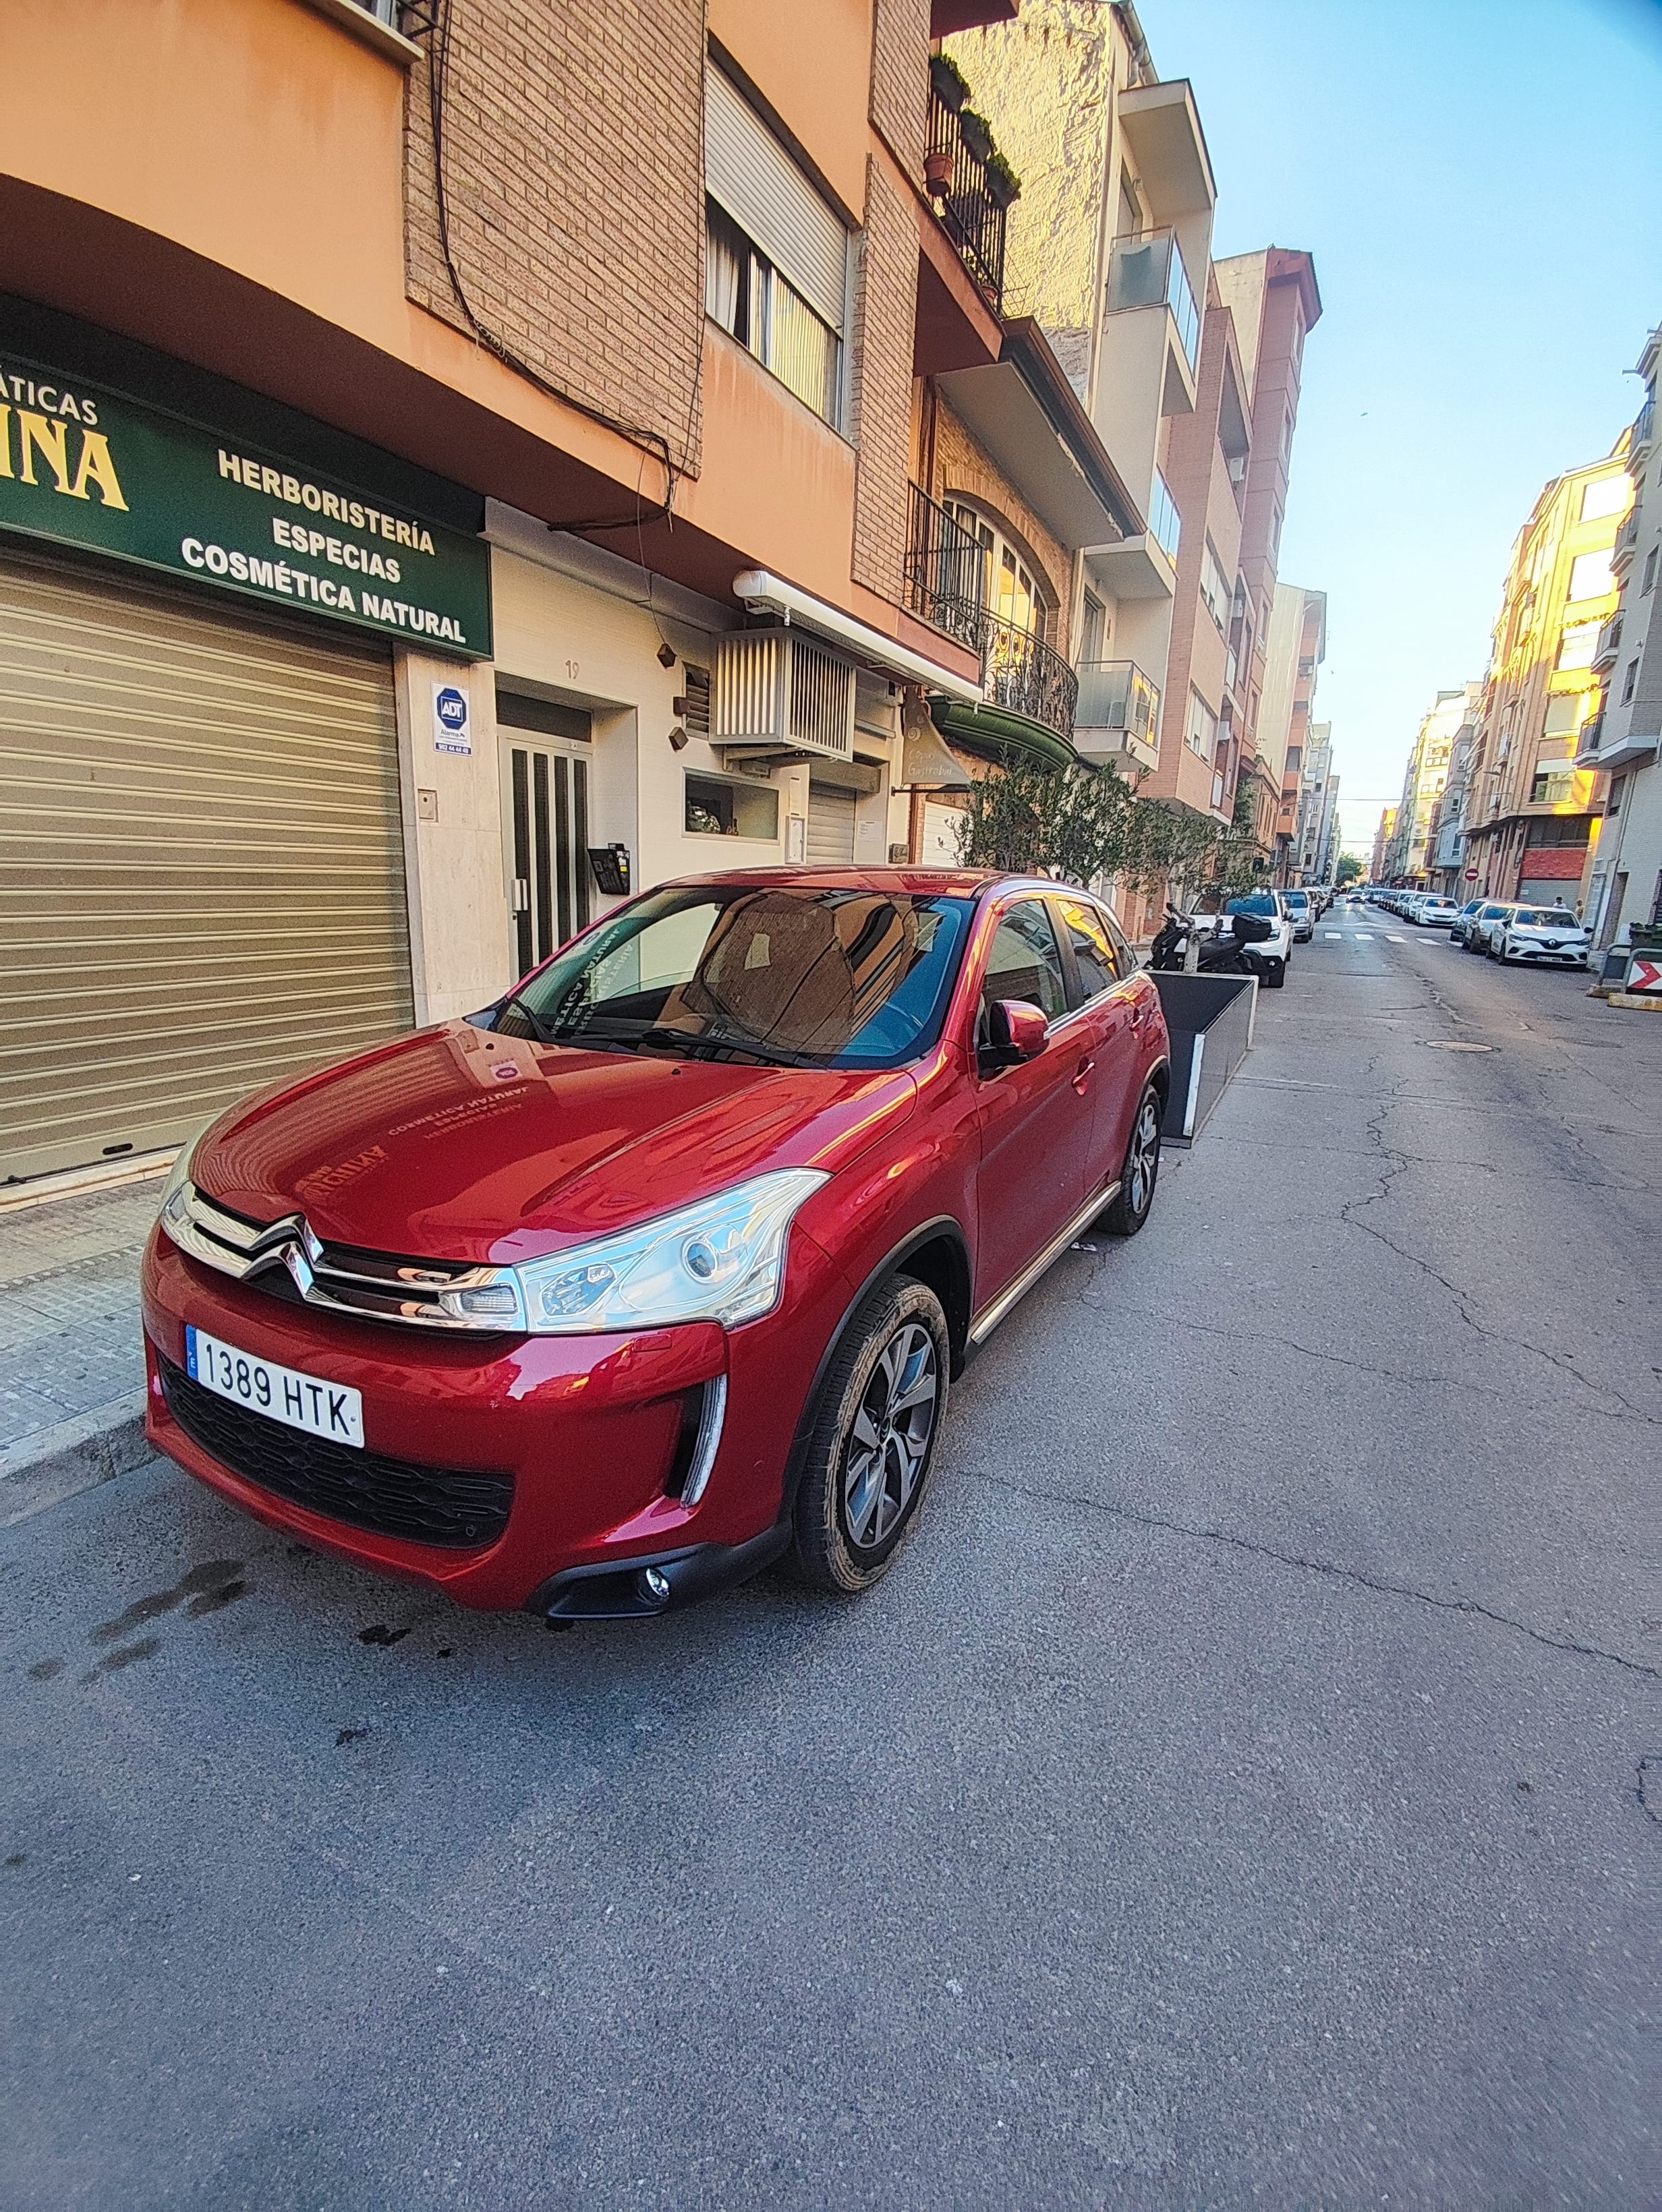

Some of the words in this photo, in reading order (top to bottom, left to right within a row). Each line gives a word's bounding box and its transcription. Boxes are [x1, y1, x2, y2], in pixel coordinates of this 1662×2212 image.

[218, 449, 435, 556] HERBORISTERÍA
[273, 517, 401, 583] ESPECIAS
[181, 537, 355, 612] COSMÉTICA
[362, 592, 467, 644] NATURAL
[565, 660, 579, 679] 19
[442, 701, 462, 718] ADT
[206, 1343, 271, 1407] 1389
[283, 1375, 350, 1436] HTK
